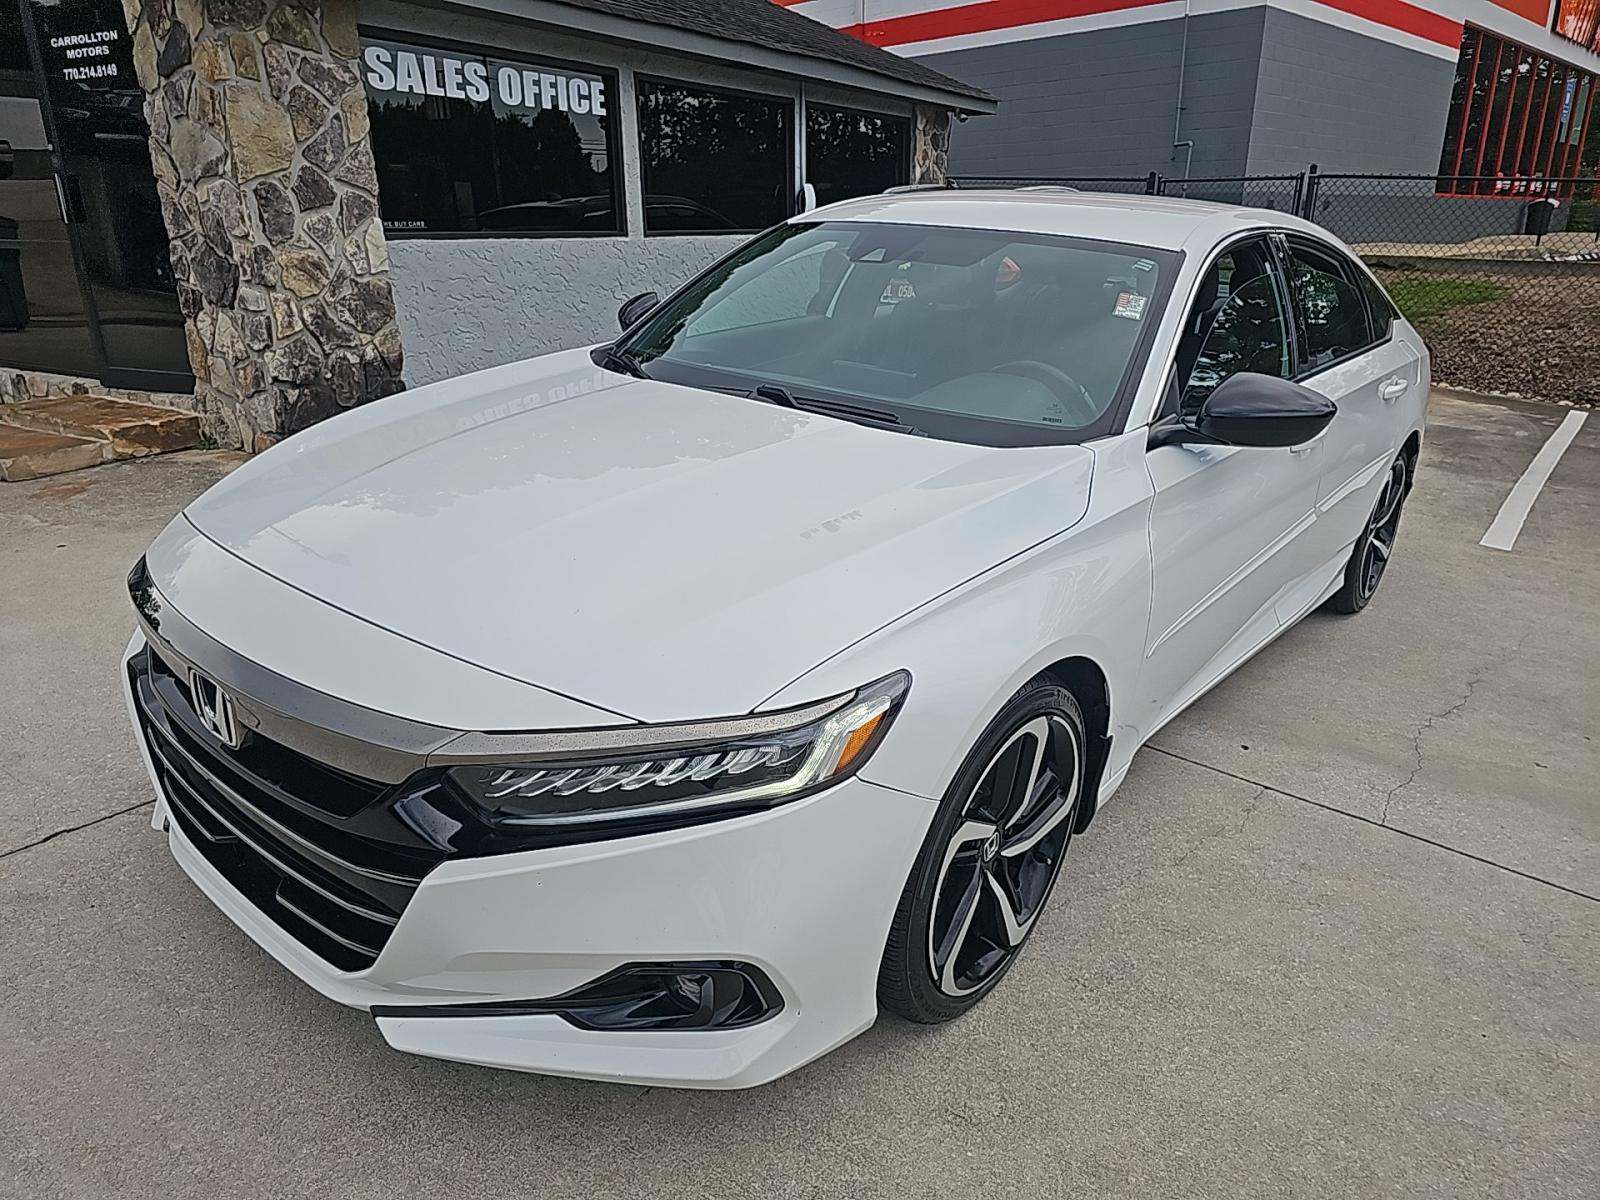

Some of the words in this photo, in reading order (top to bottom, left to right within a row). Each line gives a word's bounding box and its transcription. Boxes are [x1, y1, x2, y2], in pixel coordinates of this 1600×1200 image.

[50, 30, 118, 48] CARROLLTON
[66, 45, 110, 59] MOTORS
[63, 63, 118, 80] 770.214.8149
[364, 46, 490, 103] SALES
[498, 66, 607, 116] OFFICE
